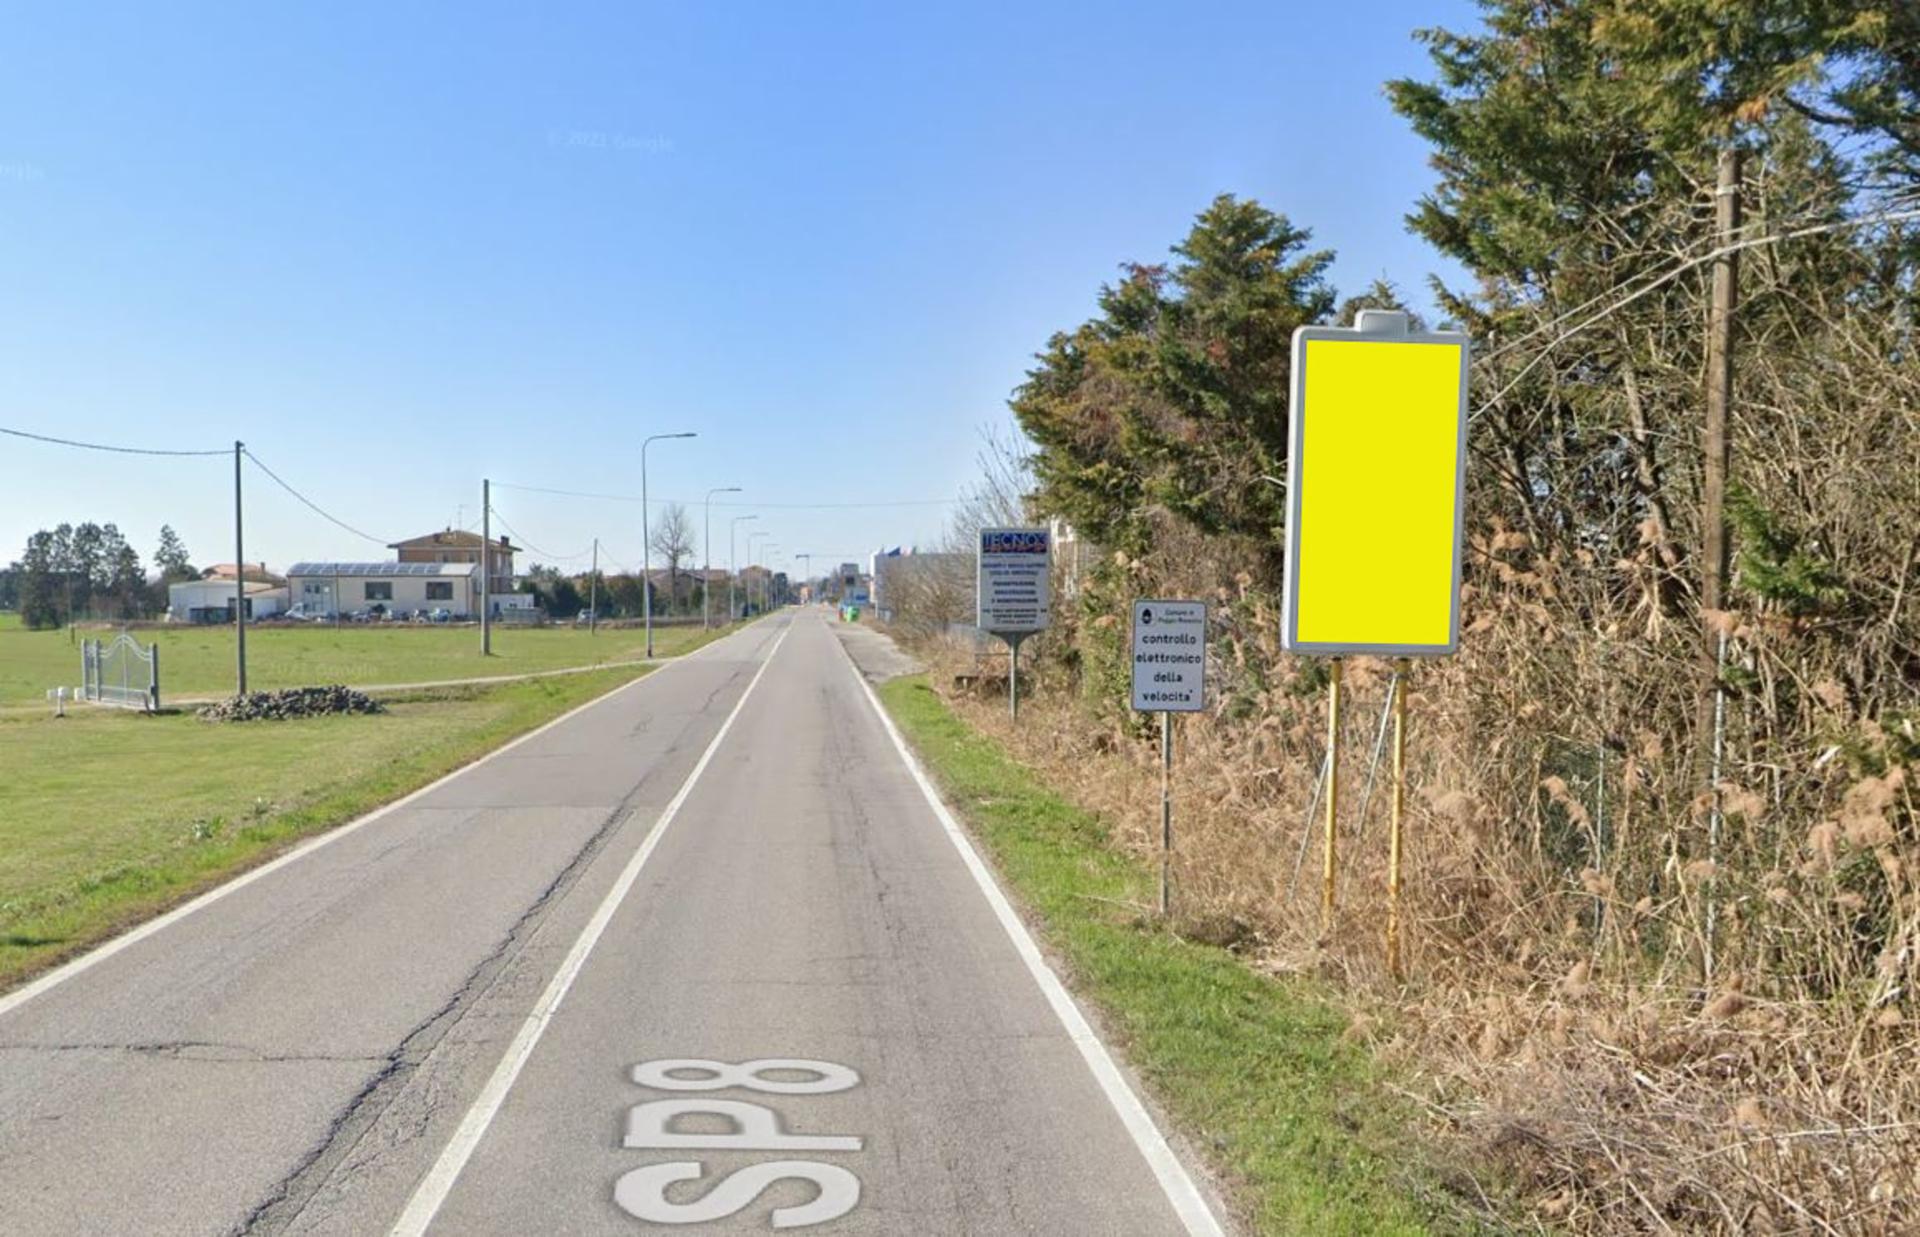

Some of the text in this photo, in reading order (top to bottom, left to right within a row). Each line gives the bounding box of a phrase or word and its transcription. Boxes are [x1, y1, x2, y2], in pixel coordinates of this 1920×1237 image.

[1142, 632, 1196, 645] controllo
[1136, 651, 1201, 664] elettronico
[1153, 672, 1183, 683] della
[614, 1058, 864, 1228] SP8
